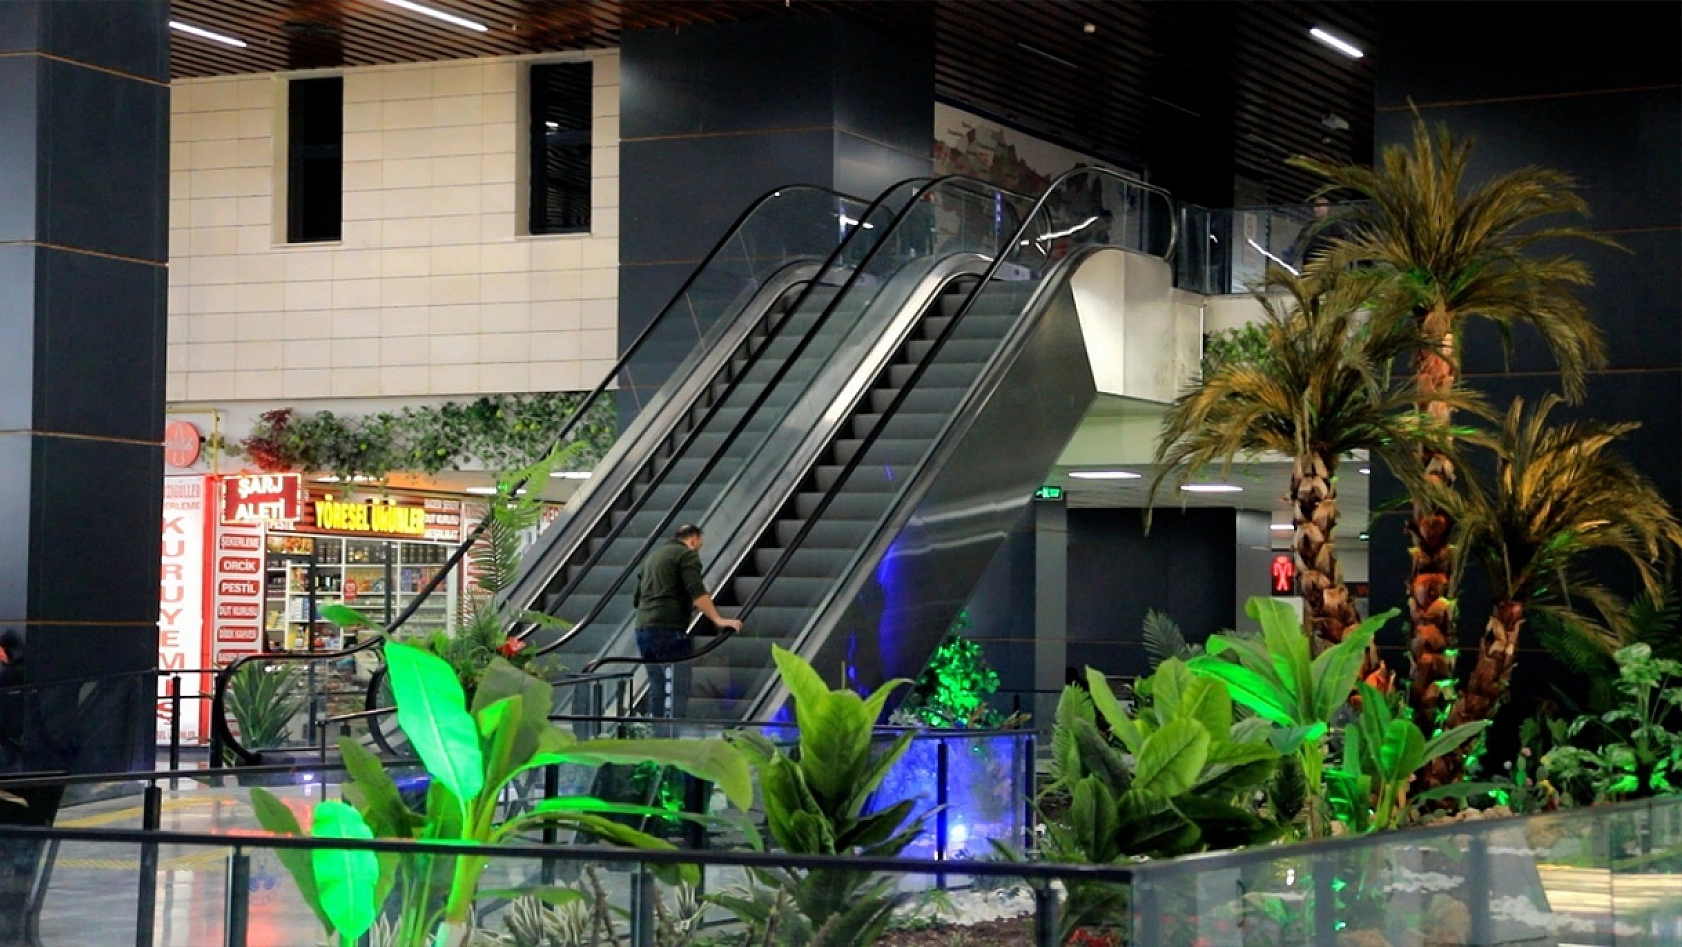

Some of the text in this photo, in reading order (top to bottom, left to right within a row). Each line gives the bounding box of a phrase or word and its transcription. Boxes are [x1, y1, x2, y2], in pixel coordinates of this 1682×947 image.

[238, 476, 283, 499] ŞARJ
[234, 498, 286, 519] ALETİ
[315, 493, 425, 534] YÖRESEL ÜRÜNLER
[223, 559, 256, 571] ORCİK
[221, 581, 257, 593] PESTİL
